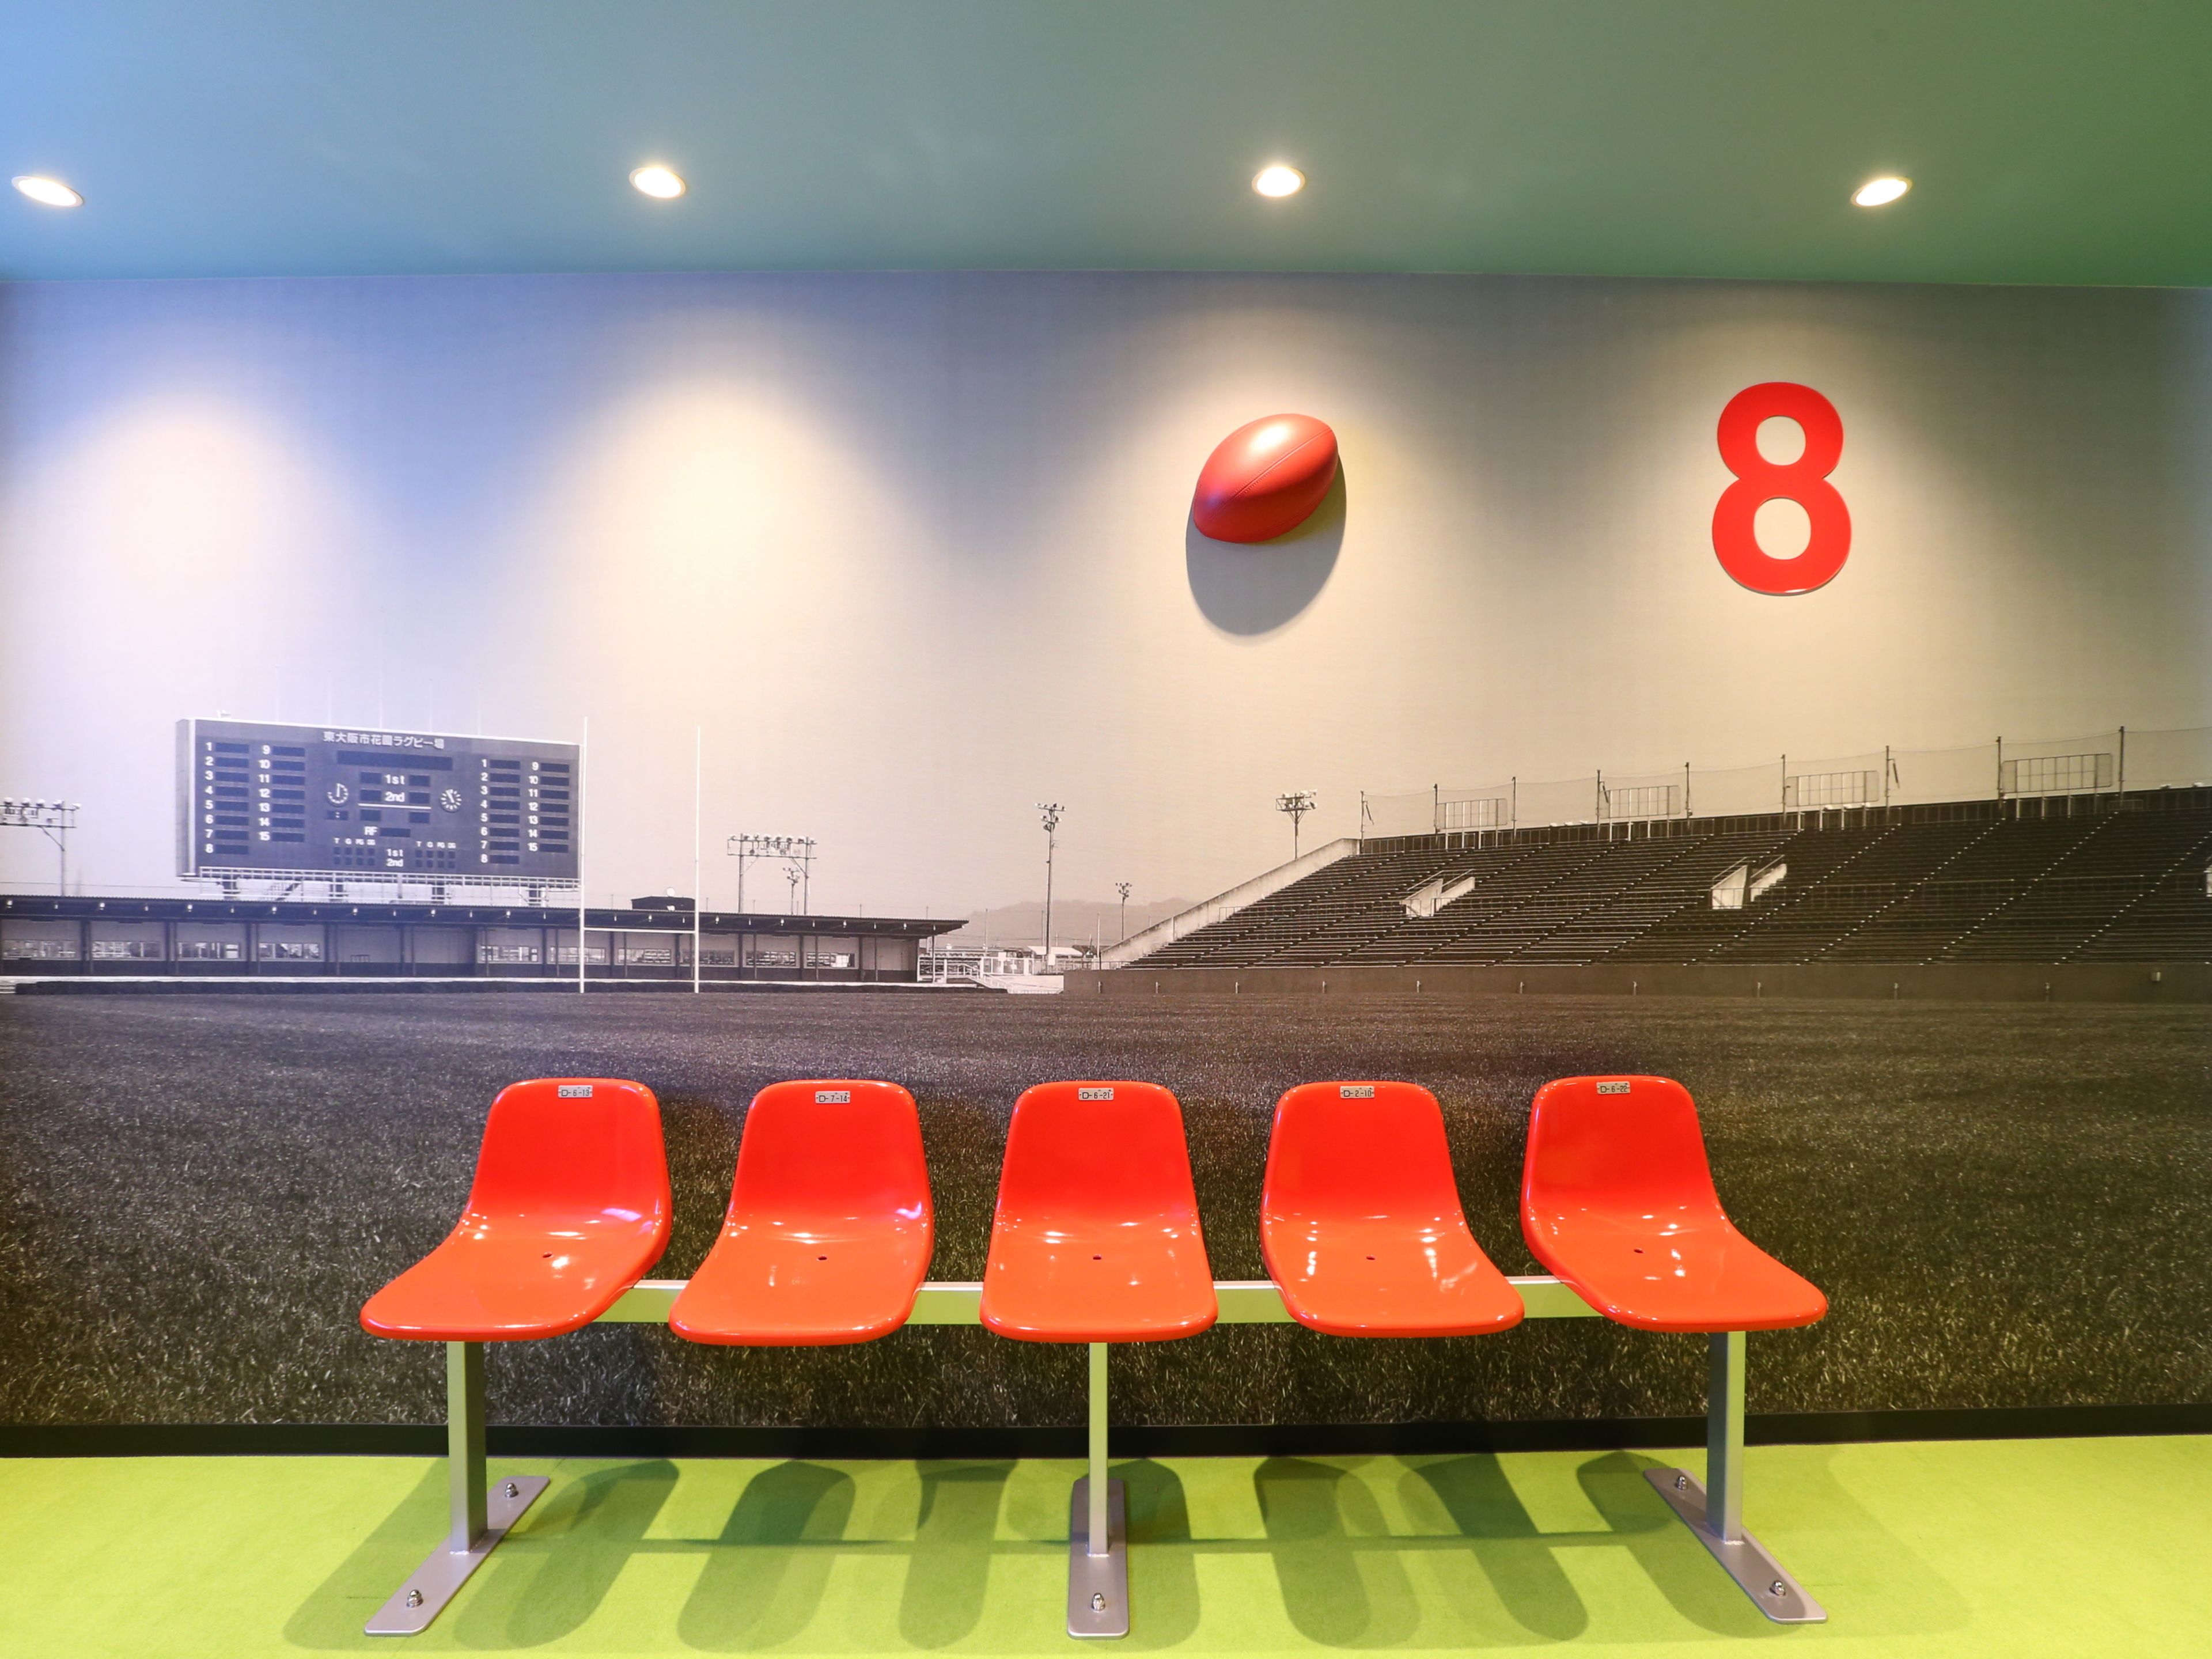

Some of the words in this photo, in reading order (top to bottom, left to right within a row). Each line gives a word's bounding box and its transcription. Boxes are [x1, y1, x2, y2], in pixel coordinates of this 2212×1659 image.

[1712, 381, 1852, 597] 8
[206, 742, 211, 751] 1
[262, 745, 270, 754] 9
[205, 756, 213, 766] 2
[258, 760, 270, 768] 10
[532, 762, 539, 770] 9
[205, 771, 213, 780] 3
[259, 774, 269, 782] 11
[385, 774, 404, 785] 1st
[481, 772, 488, 781] 2
[528, 776, 538, 784] 10
[204, 786, 213, 794] 4
[259, 789, 270, 797] 12
[480, 786, 488, 794] 3
[385, 791, 404, 802] 2nd
[205, 800, 213, 809] 5
[259, 803, 270, 812] 13
[480, 800, 487, 808] 4
[528, 802, 538, 810] 12
[205, 815, 213, 824] 6
[259, 817, 270, 826] 14
[480, 813, 488, 821] 5
[528, 816, 538, 824] 13
[205, 829, 213, 838] 7
[480, 827, 487, 835] 6
[259, 832, 270, 840] 15
[205, 844, 213, 853] 8
[480, 840, 487, 849] 7
[528, 843, 537, 851] 15
[387, 858, 403, 866] 2nd
[480, 854, 487, 863] 8
